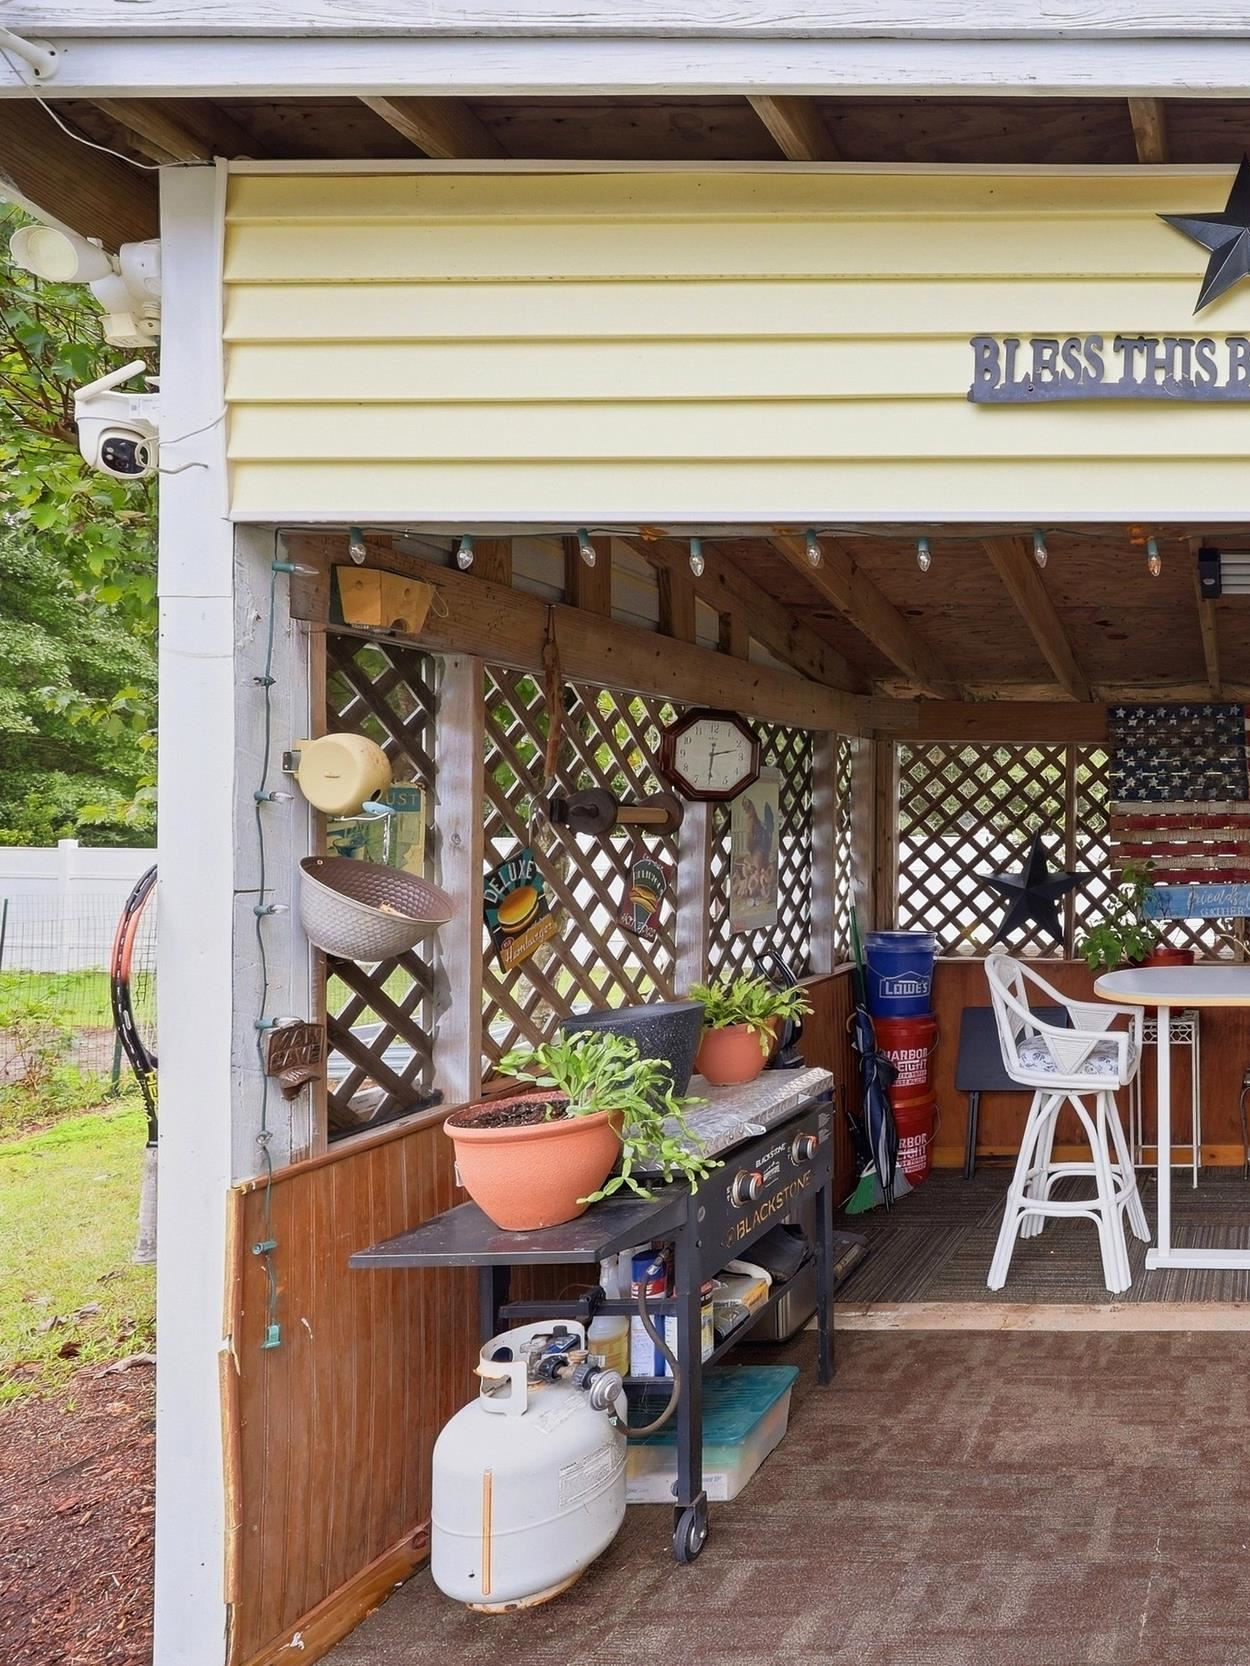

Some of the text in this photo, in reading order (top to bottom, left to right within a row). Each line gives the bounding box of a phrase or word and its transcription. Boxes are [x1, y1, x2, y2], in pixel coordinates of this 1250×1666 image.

[969, 335, 1105, 388] BLESS
[1113, 335, 1217, 387] THIS
[710, 724, 719, 734] 12
[484, 859, 534, 904] DELUXE
[899, 1132, 927, 1149] RBOR
[736, 1169, 812, 1241] BLACKSTONE
